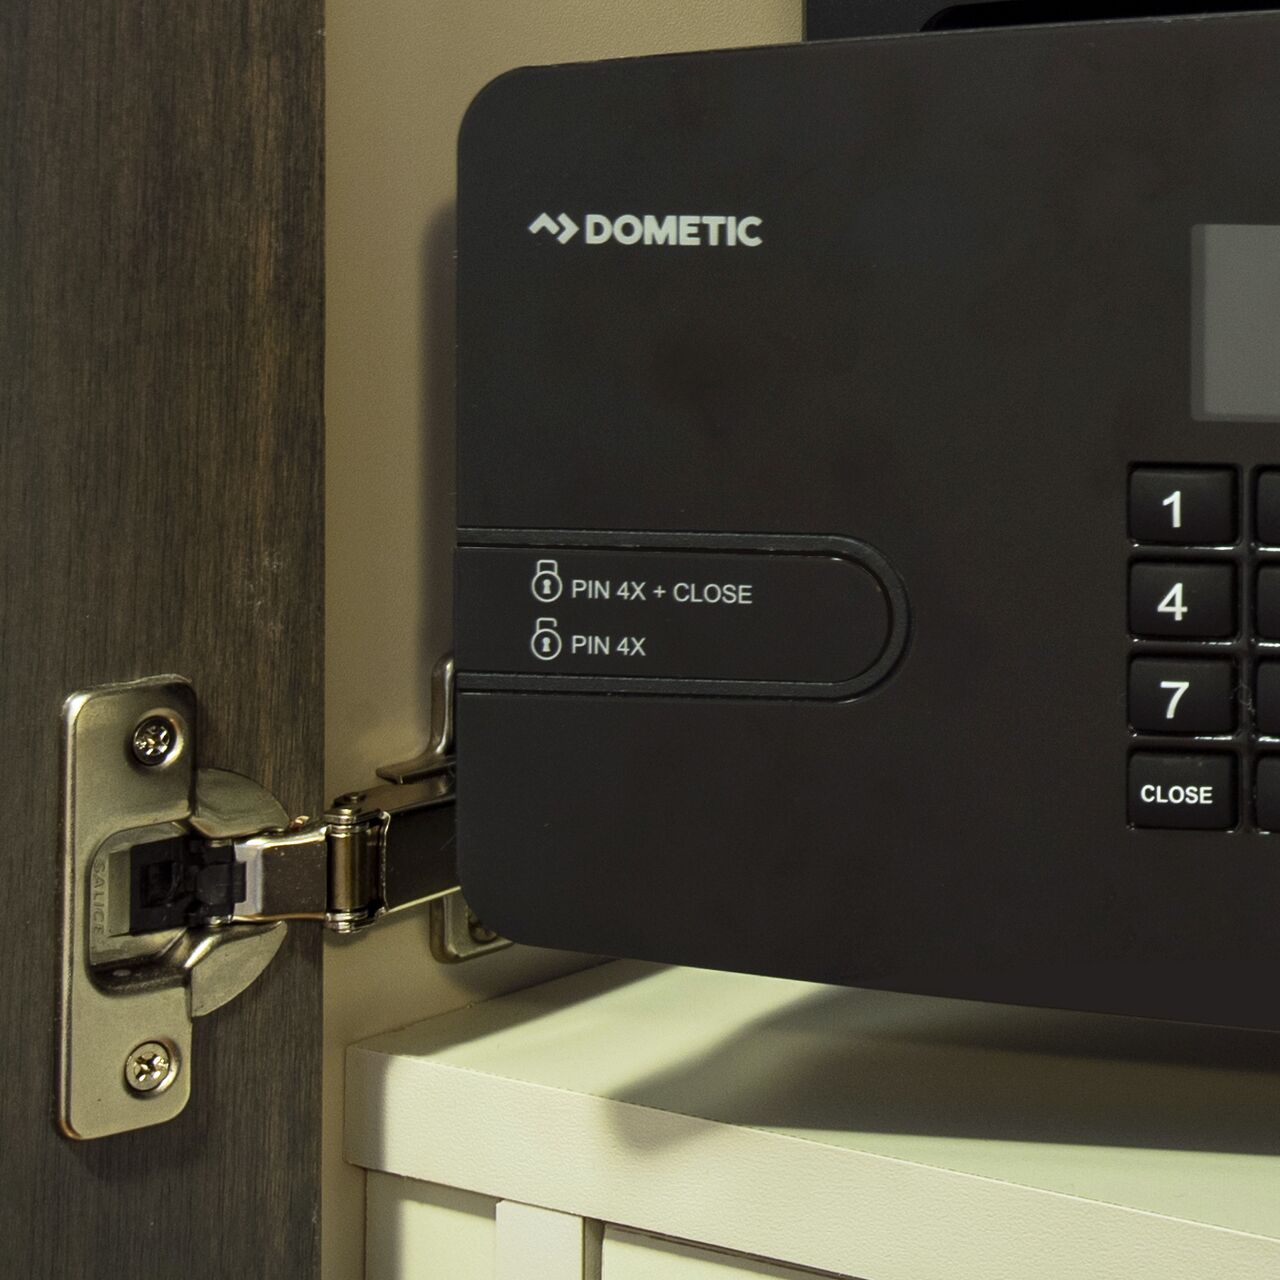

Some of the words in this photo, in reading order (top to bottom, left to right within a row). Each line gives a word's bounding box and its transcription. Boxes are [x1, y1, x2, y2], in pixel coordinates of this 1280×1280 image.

[586, 214, 762, 247] DOMETIC
[1162, 490, 1181, 528] 1
[572, 579, 610, 600] PIN
[616, 581, 647, 601] 4X
[672, 582, 753, 605] CLOSE
[1157, 582, 1188, 621] 4
[571, 634, 610, 655] PIN
[616, 636, 646, 657] 4X
[1159, 680, 1190, 719] 7
[1140, 784, 1213, 805] CLOSE
[93, 860, 106, 935] SALICE
